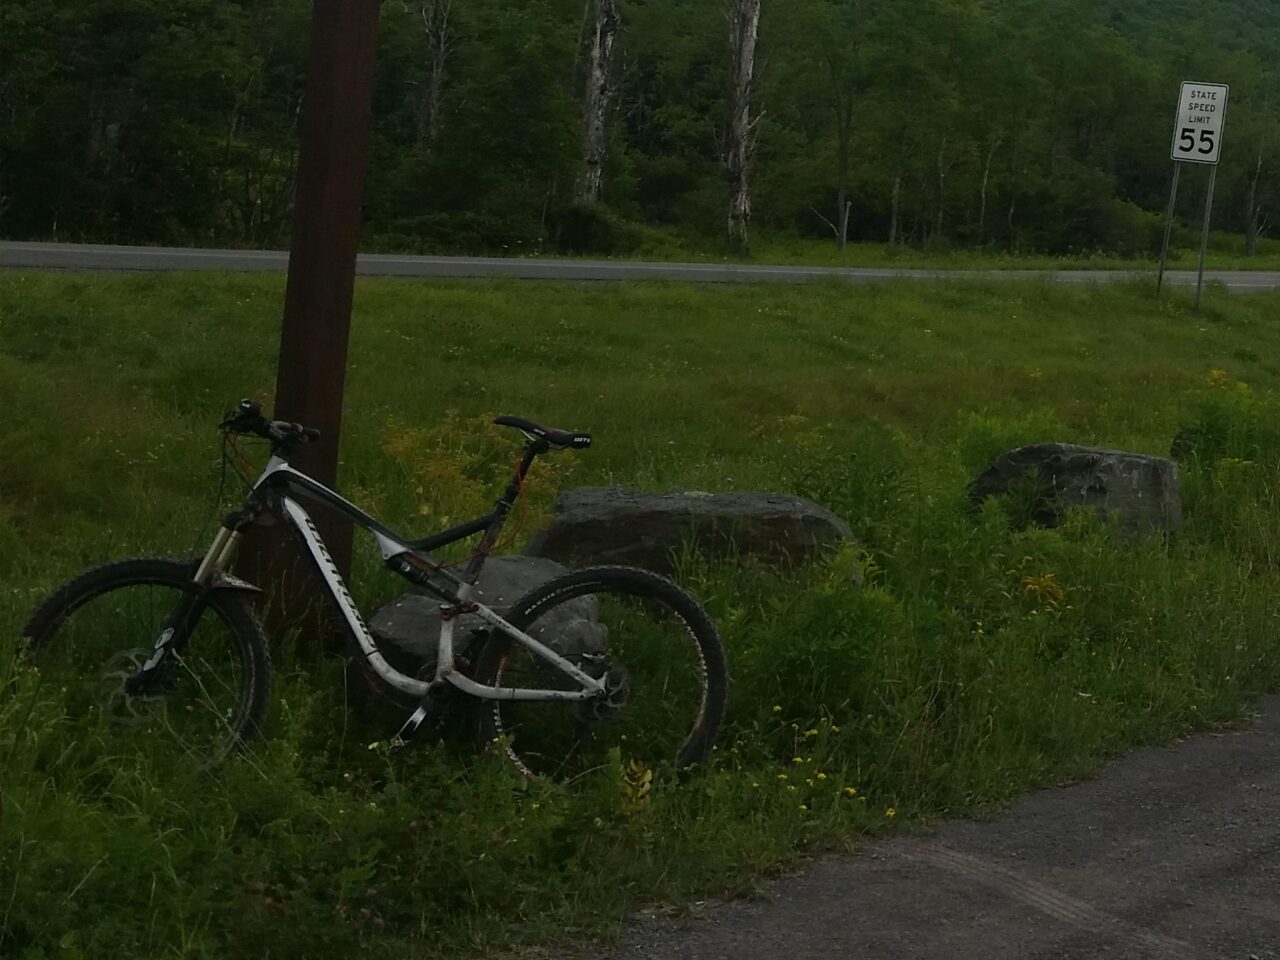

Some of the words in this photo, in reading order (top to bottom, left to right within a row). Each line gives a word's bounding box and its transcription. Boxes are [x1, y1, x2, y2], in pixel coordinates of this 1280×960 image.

[1190, 90, 1217, 100] STATE
[1188, 102, 1216, 112] SPEED
[1188, 115, 1210, 124] LIMIT
[1178, 127, 1215, 155] 55
